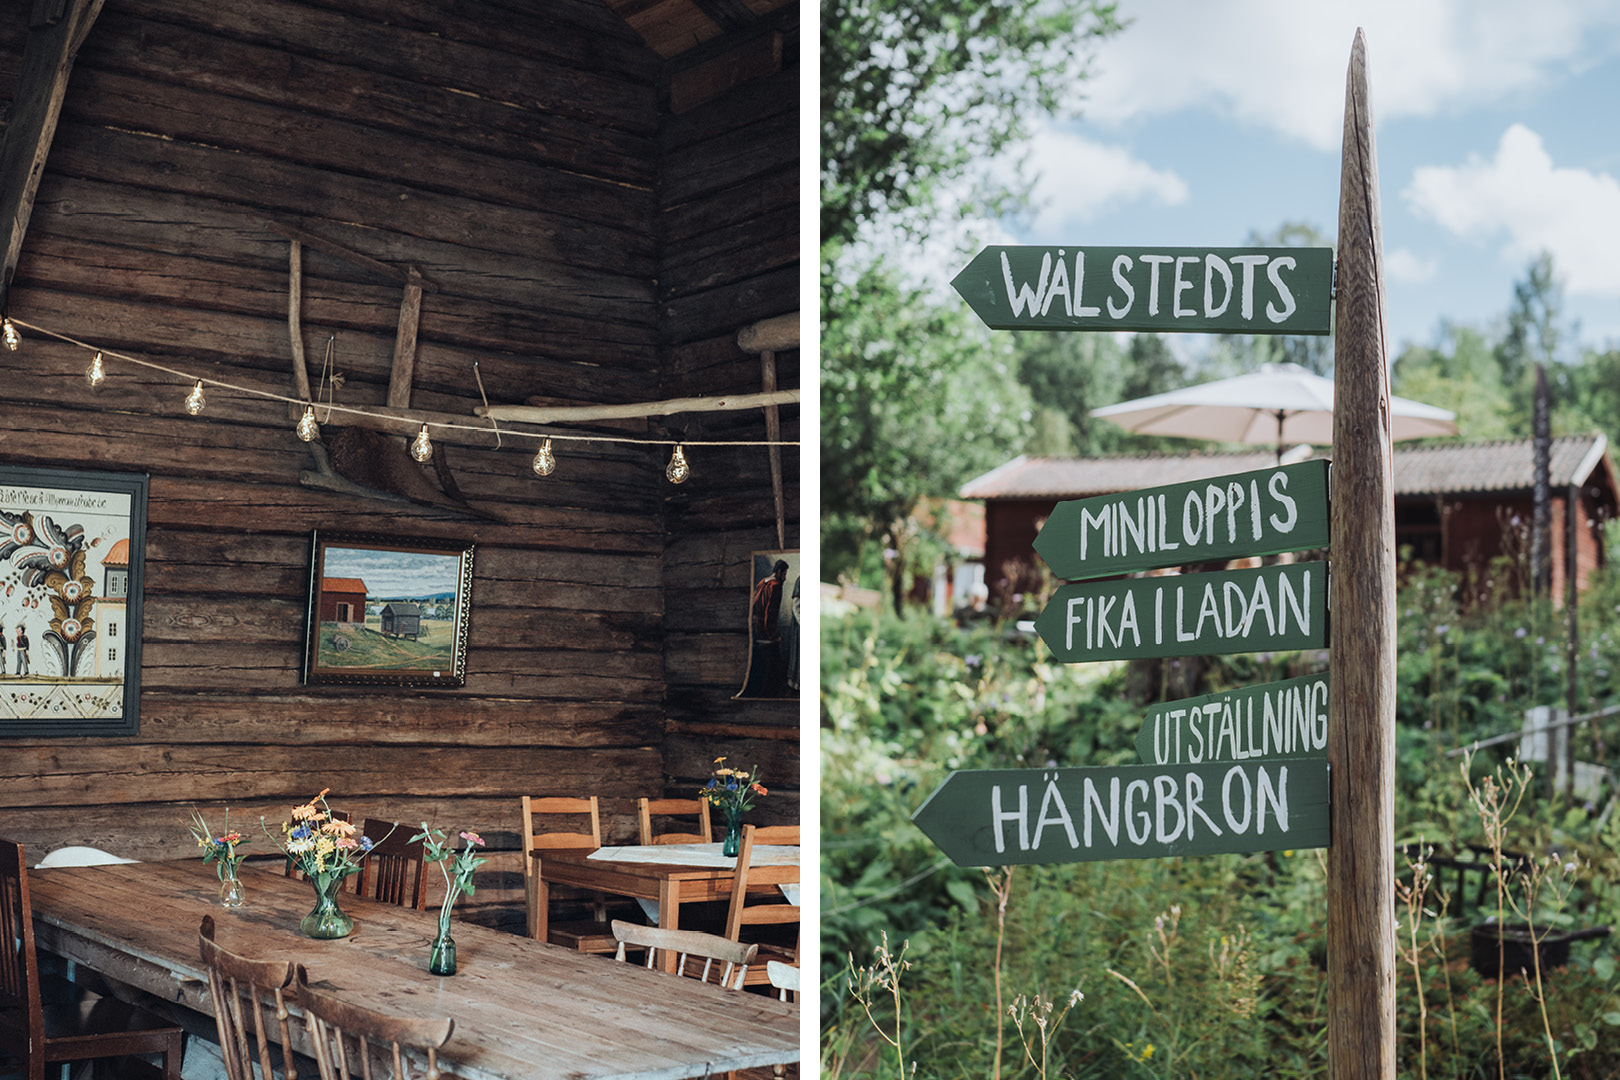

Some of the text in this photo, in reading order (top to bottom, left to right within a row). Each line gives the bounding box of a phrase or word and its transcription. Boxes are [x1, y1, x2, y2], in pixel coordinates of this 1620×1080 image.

[1066, 570, 1311, 651] FIKA I LADAN
[991, 765, 1290, 853] HÄNGBRON
